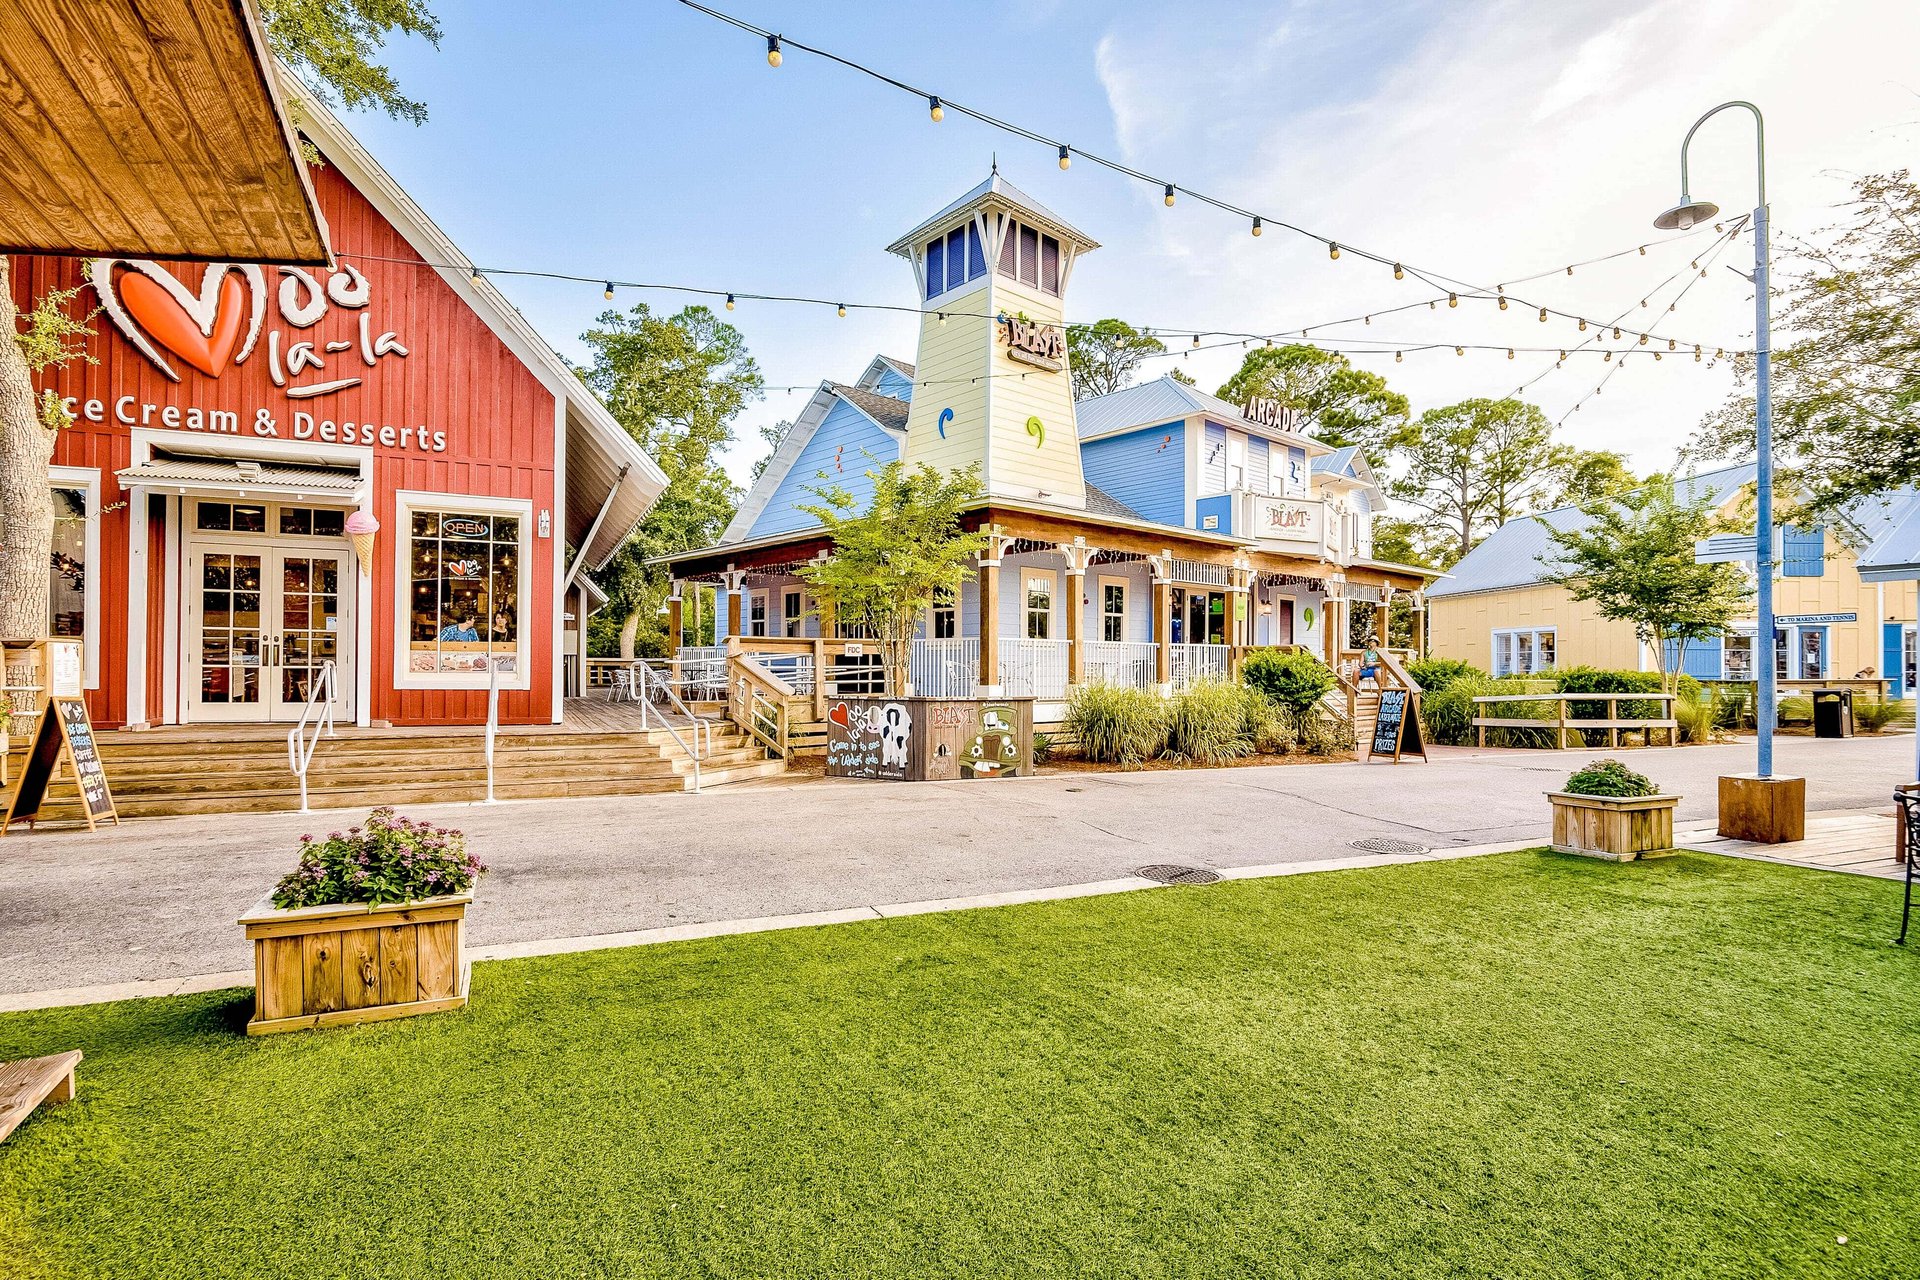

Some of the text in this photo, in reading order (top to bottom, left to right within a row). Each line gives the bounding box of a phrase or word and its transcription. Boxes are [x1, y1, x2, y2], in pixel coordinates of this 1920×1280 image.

[50, 393, 447, 452] ce Cream & Desserts
[1270, 506, 1308, 528] BLAST
[445, 523, 484, 533] OPEN
[847, 646, 861, 654] FDC
[933, 704, 974, 727] BLAST
[829, 739, 849, 753] Come
[850, 743, 857, 751] in
[859, 743, 867, 751] to
[1374, 738, 1396, 751] PRIZES
